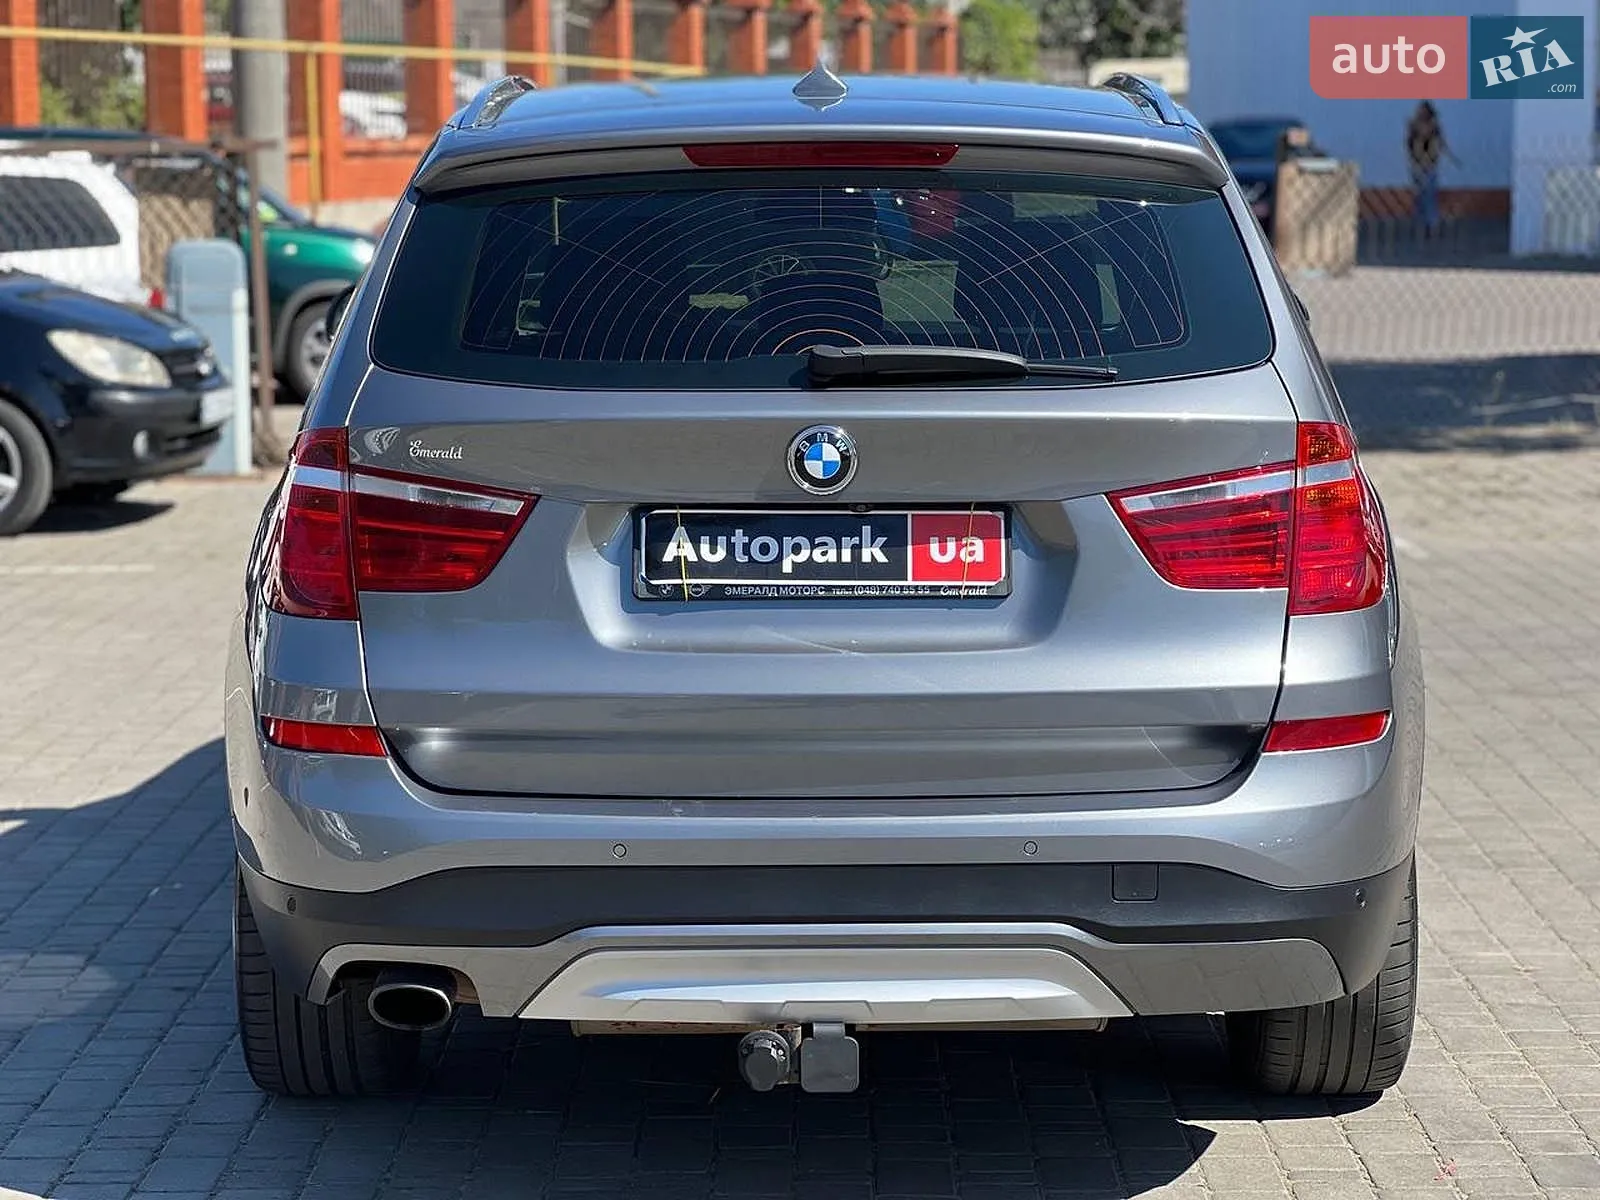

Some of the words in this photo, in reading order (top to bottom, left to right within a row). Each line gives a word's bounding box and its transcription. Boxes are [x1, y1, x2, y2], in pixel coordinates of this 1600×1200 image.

[408, 439, 463, 460] Emerald
[798, 432, 848, 452] BMW
[661, 525, 889, 574] Autopark
[928, 535, 986, 564] ua
[724, 585, 778, 597] ЭМЕРАЛД
[779, 585, 826, 596] МОТОРС
[853, 585, 880, 596] (048)
[882, 585, 901, 595] 740
[903, 585, 914, 595] 55
[917, 585, 930, 595] 55
